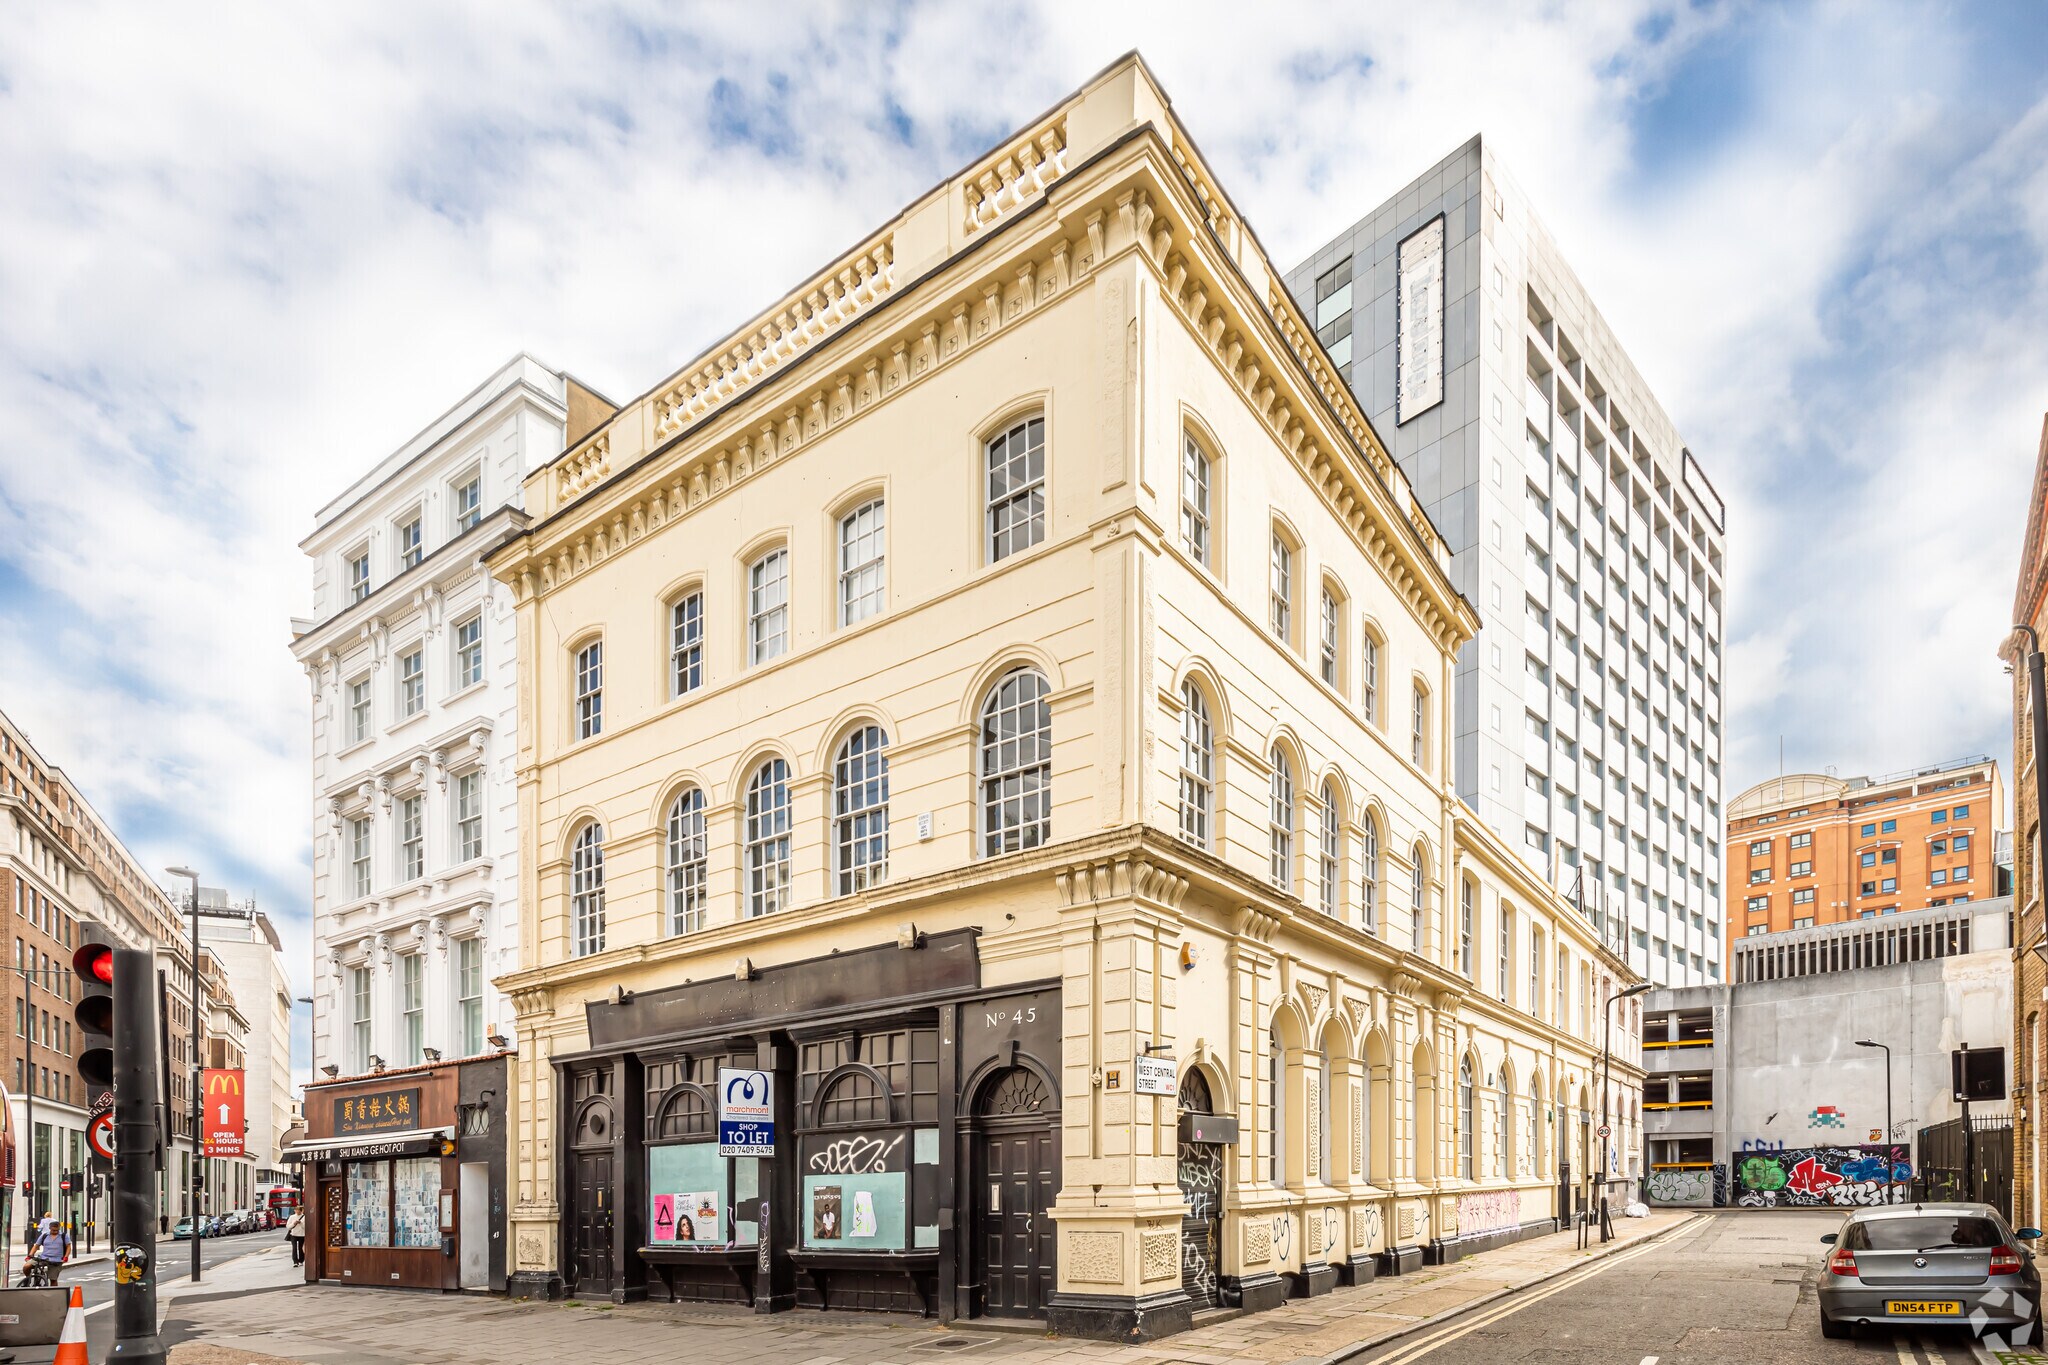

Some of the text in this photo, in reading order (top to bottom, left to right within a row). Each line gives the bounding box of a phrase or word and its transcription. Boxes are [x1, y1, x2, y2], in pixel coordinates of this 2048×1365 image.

[1012, 1007, 1036, 1024] 45
[1138, 1065, 1176, 1078] WEST CENTRAL
[1138, 1078, 1157, 1089] STREET
[726, 1105, 769, 1114] marchmont
[739, 1123, 758, 1131] SHOP
[727, 1131, 769, 1144] TO LET
[339, 1142, 405, 1158] SHU XIANG GE HOT POT
[722, 1145, 773, 1154] 020 7409 5475
[1893, 1303, 1953, 1313] DN54 FTP
